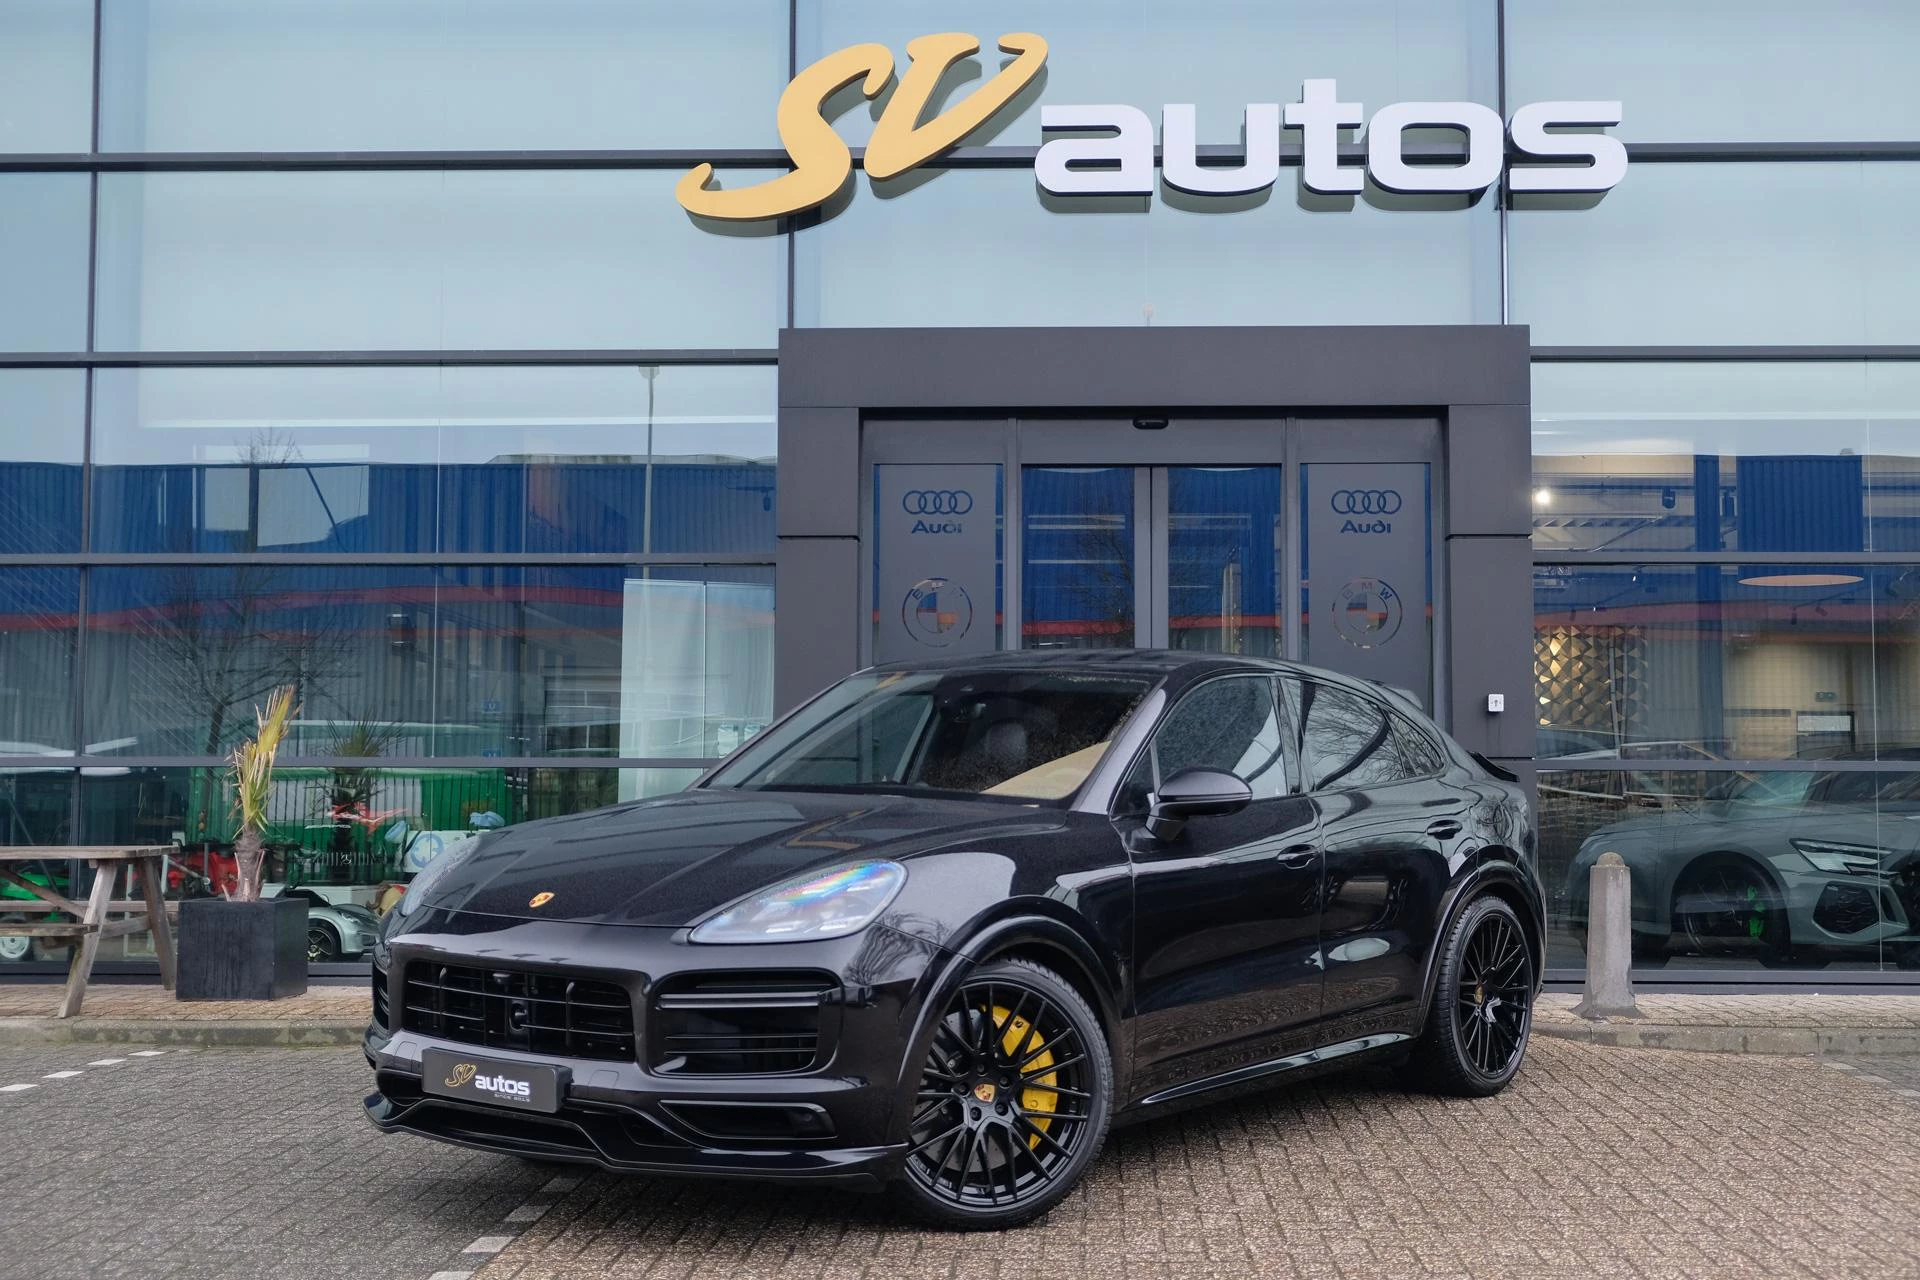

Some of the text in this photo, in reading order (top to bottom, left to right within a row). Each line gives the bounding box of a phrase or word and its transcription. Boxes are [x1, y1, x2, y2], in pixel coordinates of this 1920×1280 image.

[675, 32, 1629, 221] SV autos
[911, 520, 962, 534] Audi
[1340, 520, 1392, 534] Audi
[474, 1075, 530, 1096] autos
